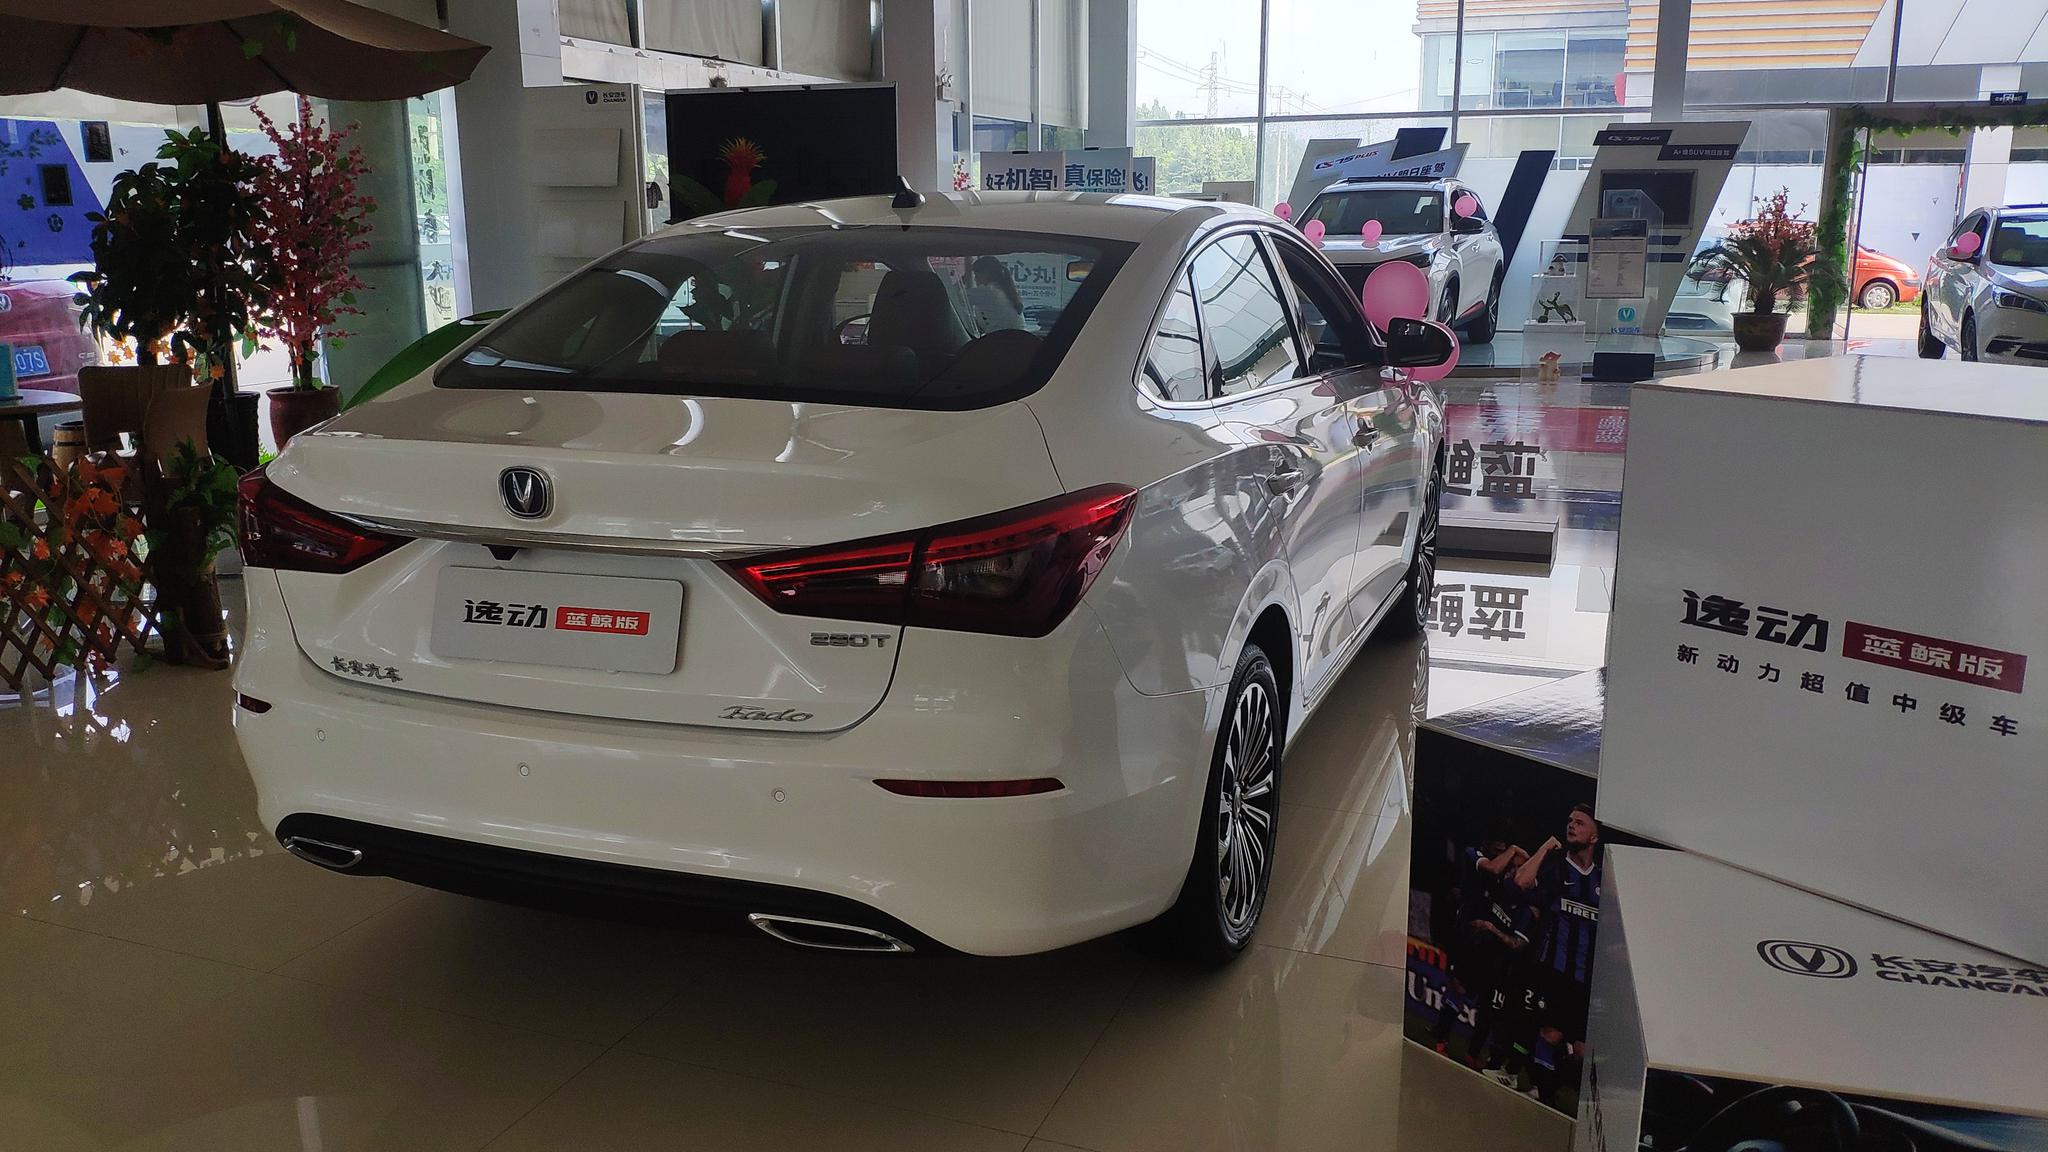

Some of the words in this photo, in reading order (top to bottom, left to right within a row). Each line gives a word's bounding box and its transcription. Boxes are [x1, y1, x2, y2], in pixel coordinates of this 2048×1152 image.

[1064, 163, 1126, 187] 真保险!
[1002, 260, 1057, 284] 心丸!
[14, 351, 45, 371] 07S
[462, 599, 549, 629] 逸动
[565, 612, 639, 631] 蓝鲸版
[1679, 588, 1830, 653] 逸动
[1861, 633, 2005, 681] 蓝鲸版
[330, 655, 404, 683] 长安汽车
[1676, 643, 2019, 737] 新动力超值中级车
